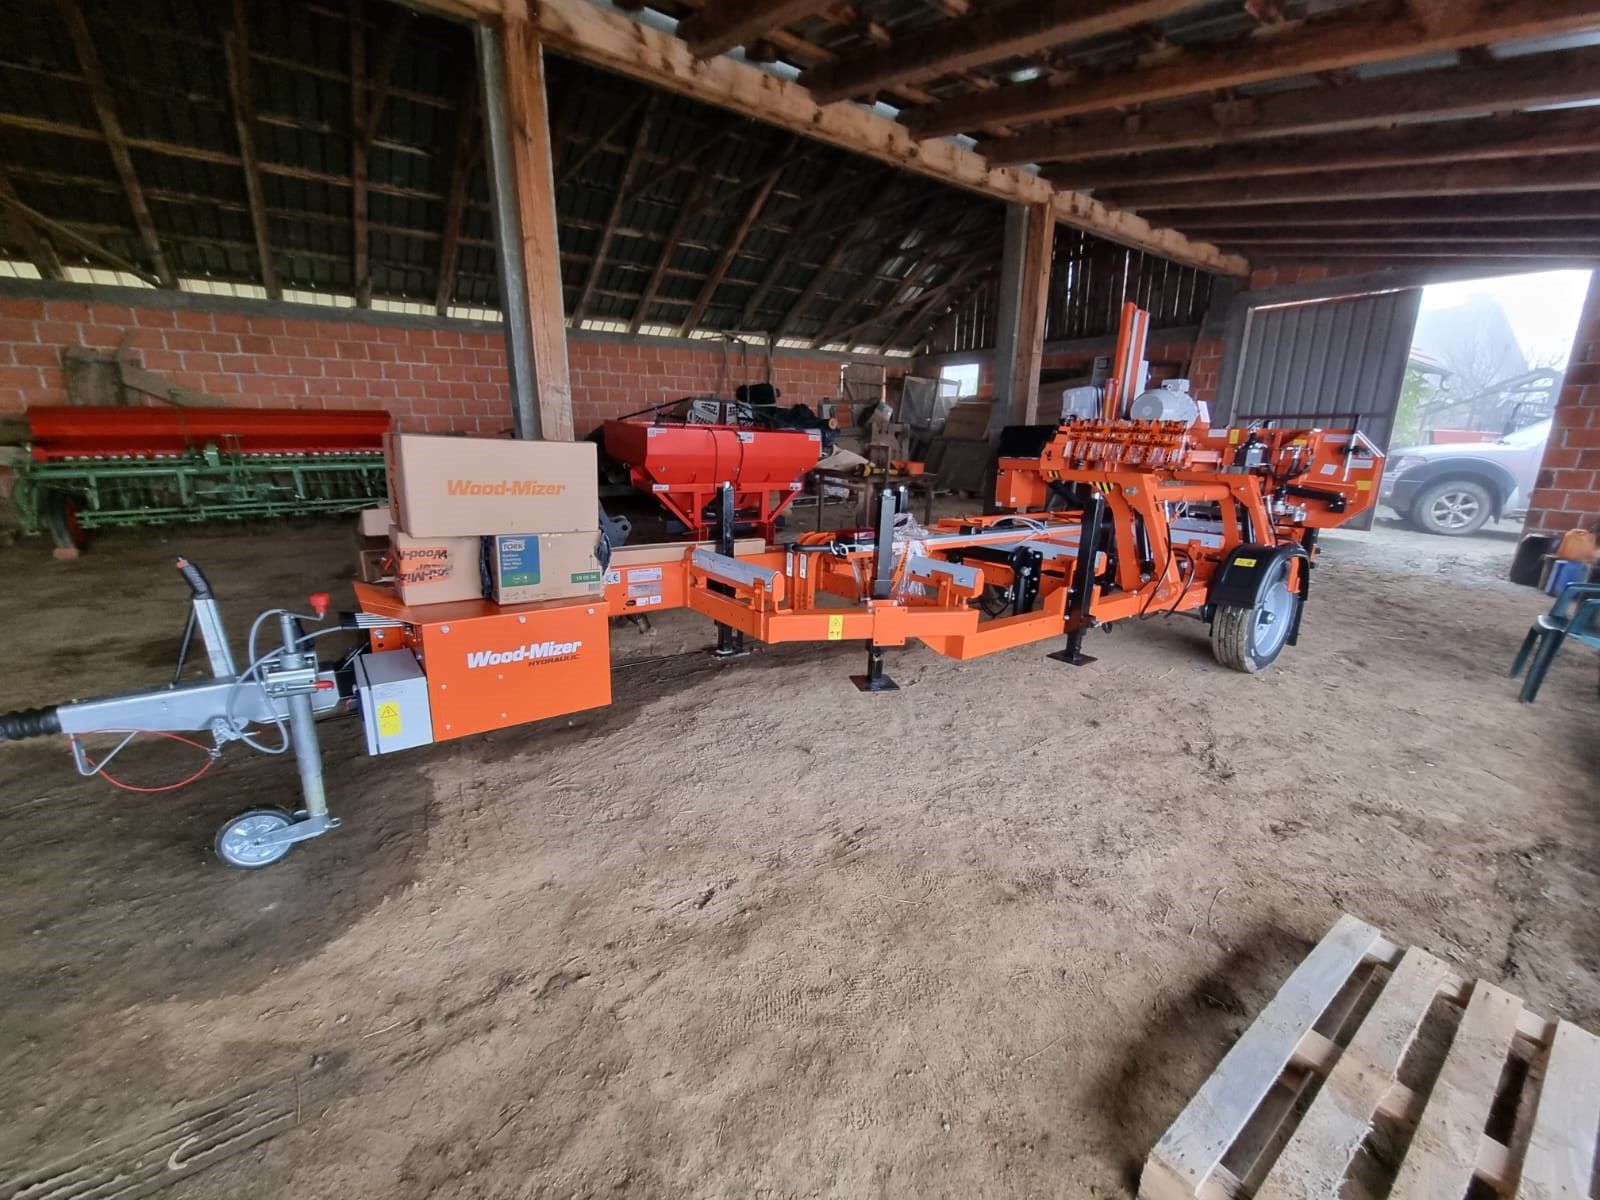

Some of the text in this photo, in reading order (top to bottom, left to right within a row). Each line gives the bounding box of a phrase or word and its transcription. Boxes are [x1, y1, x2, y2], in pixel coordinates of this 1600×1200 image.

[447, 479, 566, 496] Wood-Mizer
[503, 542, 524, 551] TORK
[467, 640, 582, 669] Wood-Mizer
